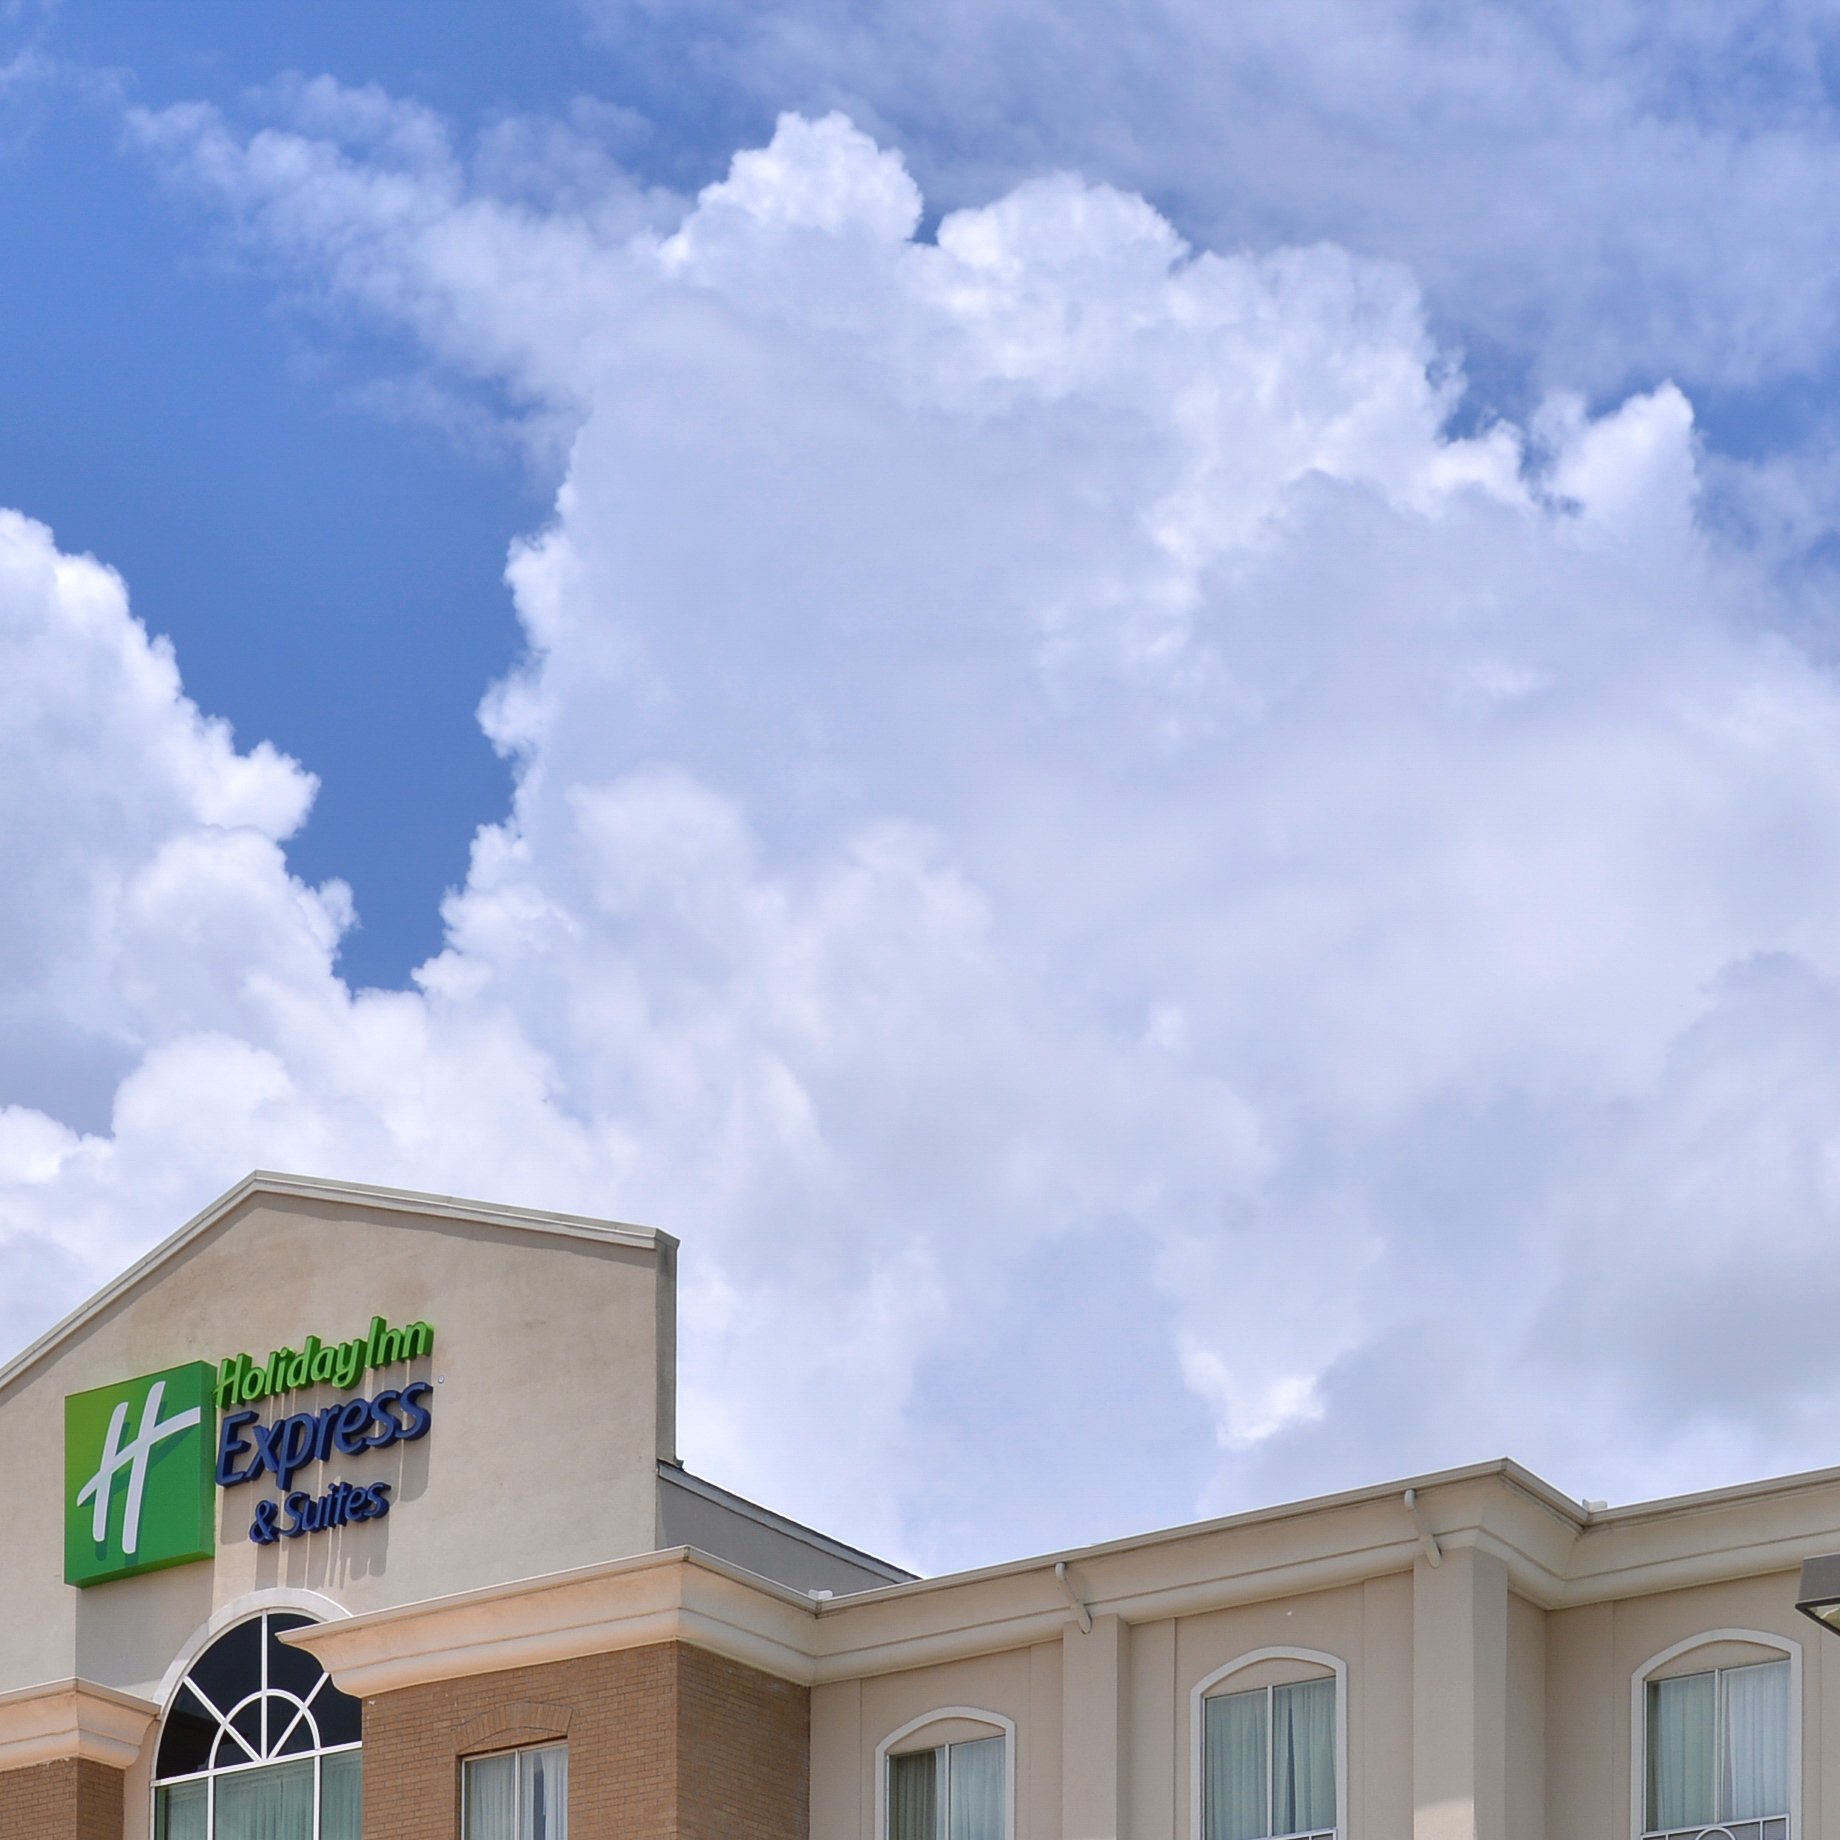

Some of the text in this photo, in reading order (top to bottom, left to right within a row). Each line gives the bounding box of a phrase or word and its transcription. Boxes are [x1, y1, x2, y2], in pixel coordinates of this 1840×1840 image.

[213, 1316, 435, 1409] Holiday Inn
[215, 1381, 434, 1491] Express
[248, 1481, 392, 1545] & Suites
